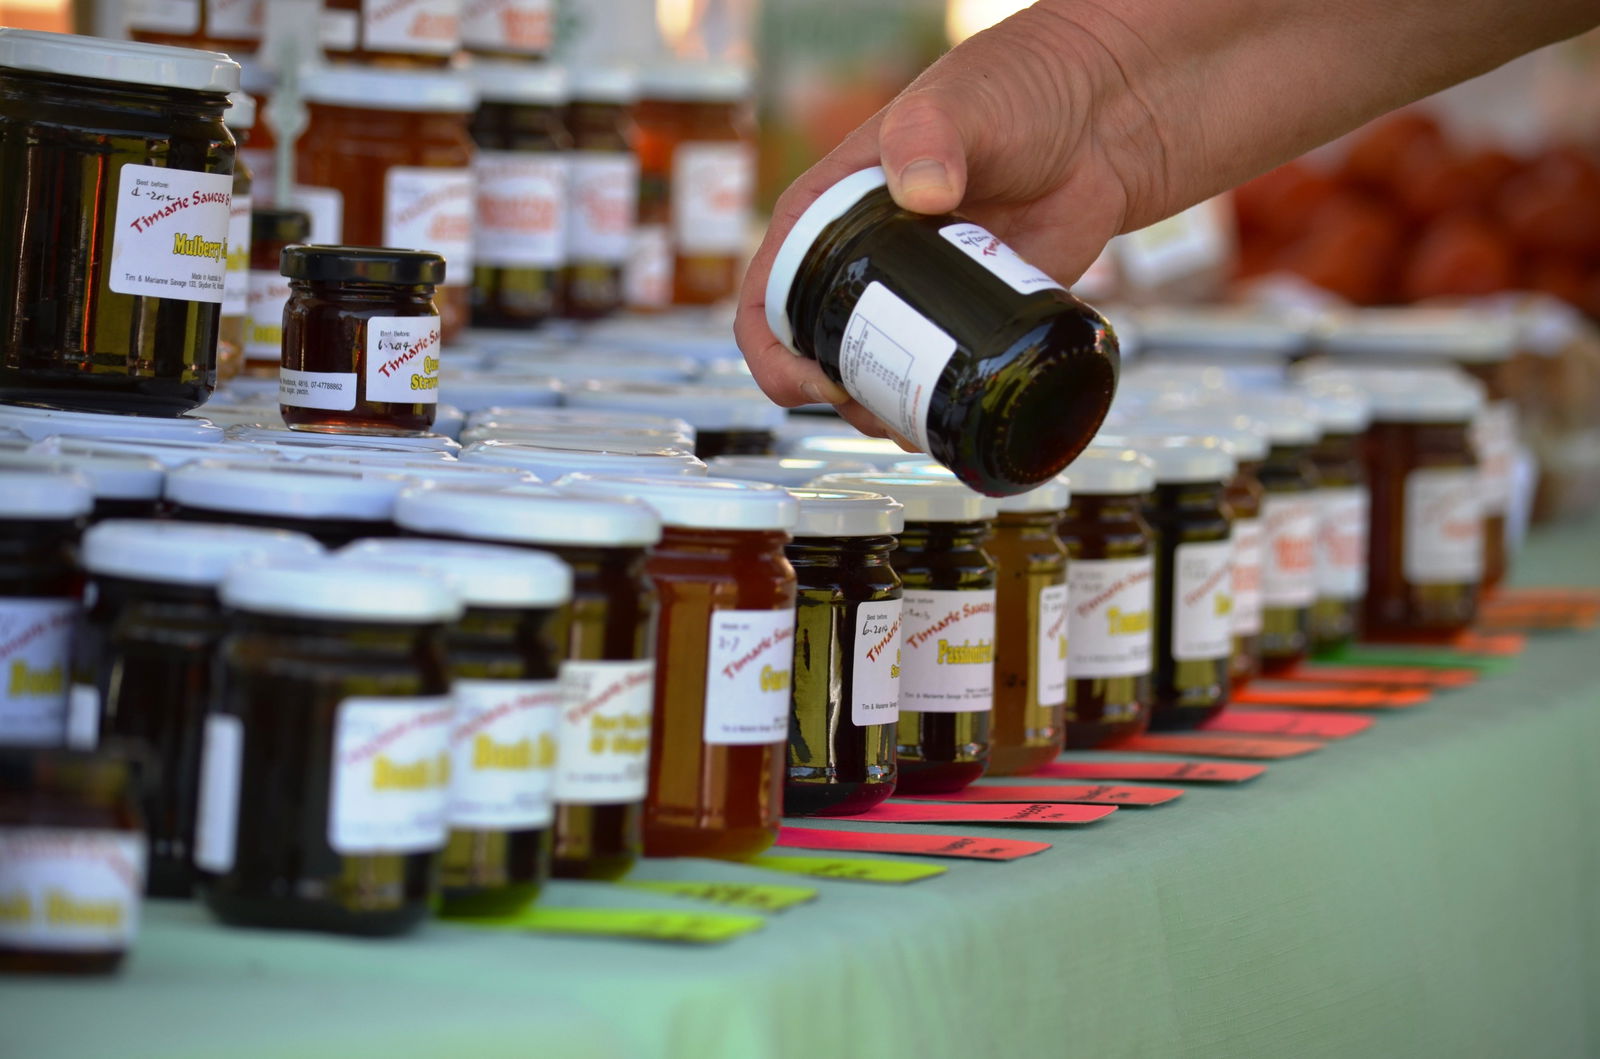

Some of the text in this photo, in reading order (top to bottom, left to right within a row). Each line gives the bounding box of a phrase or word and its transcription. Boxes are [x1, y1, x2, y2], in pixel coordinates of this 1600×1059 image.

[130, 197, 189, 234] Timarie
[192, 190, 226, 206] Sauces
[173, 232, 222, 263] Mulberry
[125, 273, 136, 281] Tim
[145, 276, 169, 285] Marianne
[378, 338, 429, 378] Timarie
[866, 621, 898, 663] Timarie
[906, 610, 960, 649] Timarie
